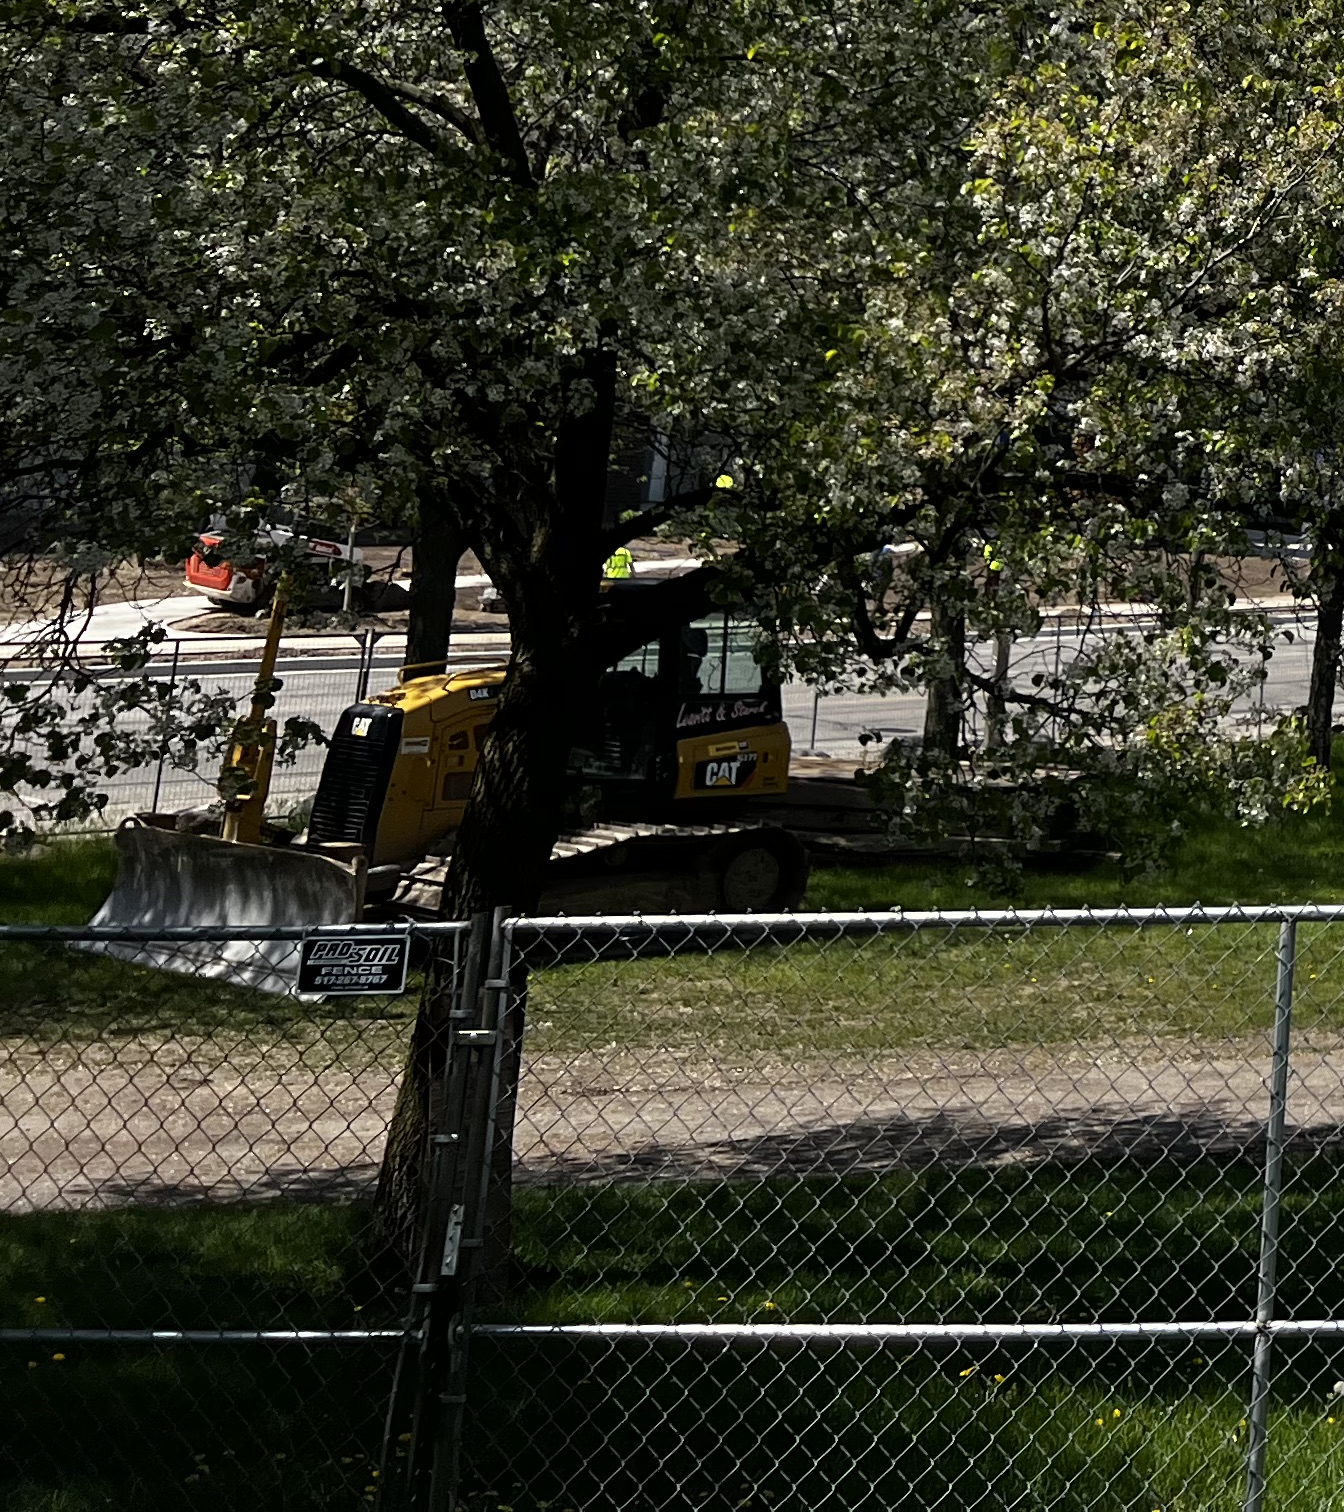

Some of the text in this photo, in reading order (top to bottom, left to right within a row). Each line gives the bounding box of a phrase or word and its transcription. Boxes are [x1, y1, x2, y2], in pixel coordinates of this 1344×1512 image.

[352, 717, 372, 736] CAT
[705, 762, 741, 786] CAT
[321, 966, 383, 975] FENCE
